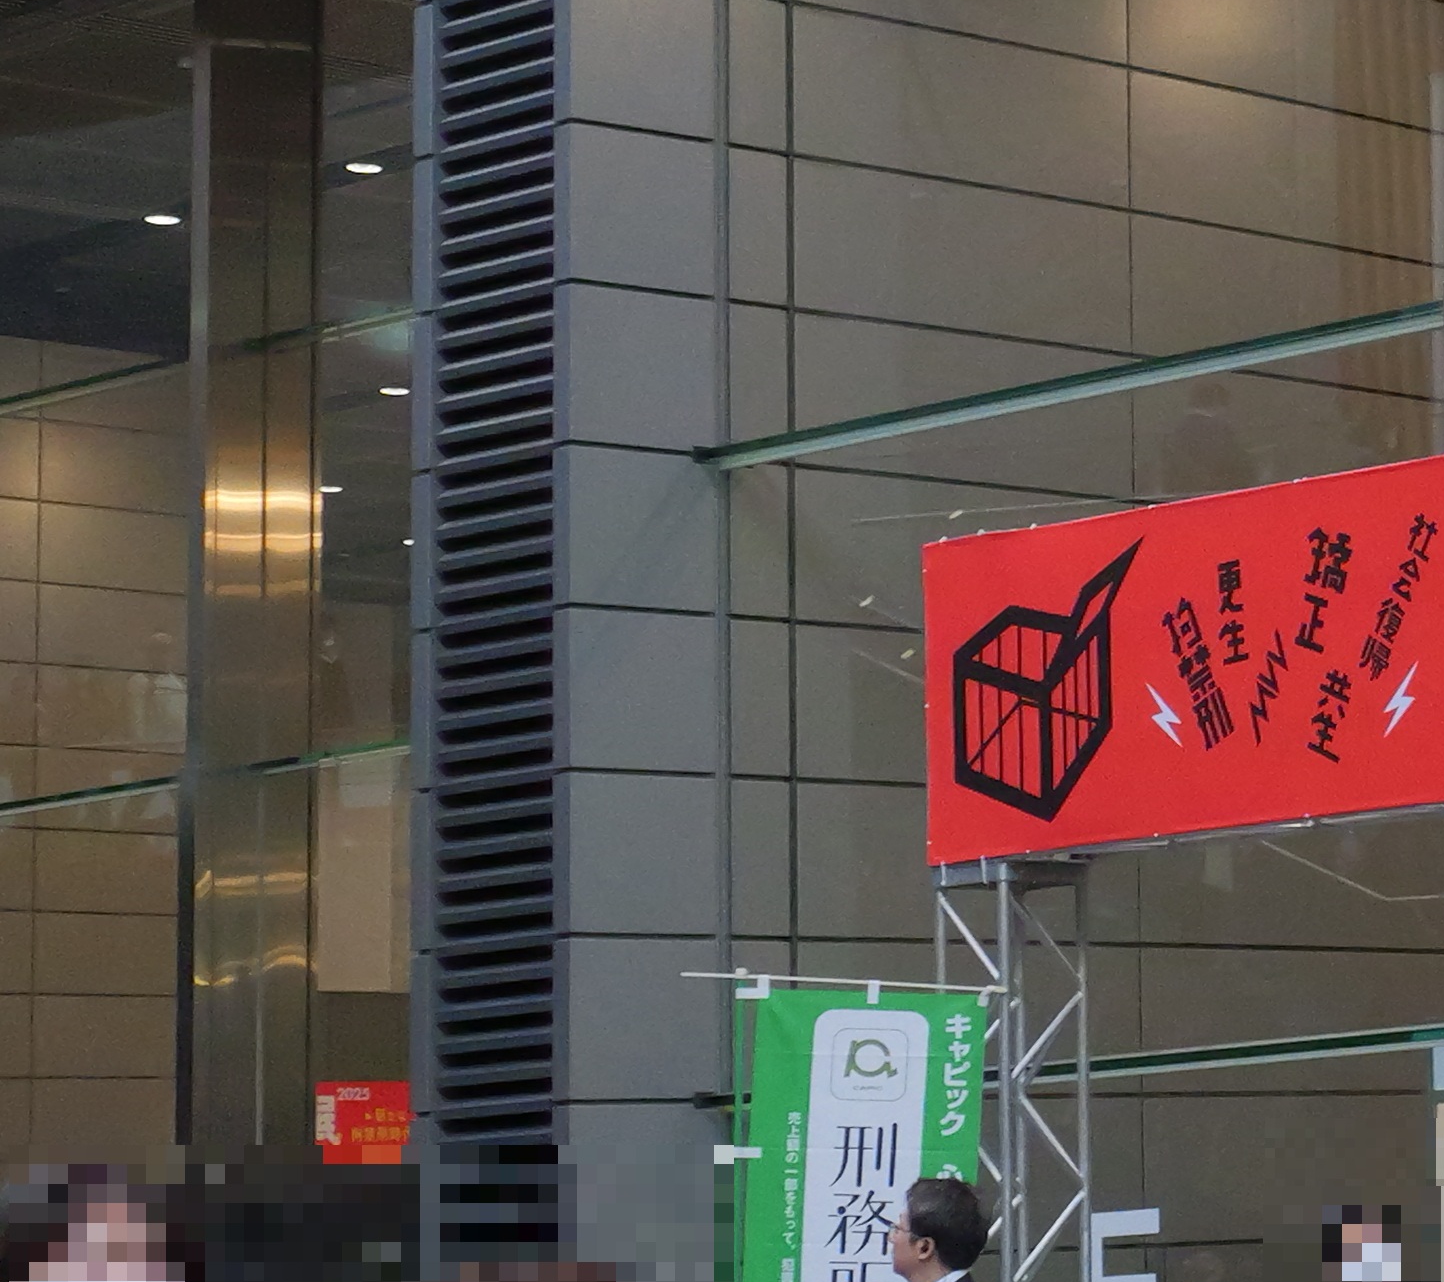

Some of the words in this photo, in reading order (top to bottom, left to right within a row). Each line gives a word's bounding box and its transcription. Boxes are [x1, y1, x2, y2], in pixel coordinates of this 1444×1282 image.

[1217, 559, 1249, 666] 更生
[1294, 527, 1353, 654] 矯正
[1359, 513, 1438, 681] 社会復帰
[1161, 597, 1236, 752] 拘禁刑
[1306, 669, 1352, 764] 共生
[940, 1013, 972, 1137] キャピック
